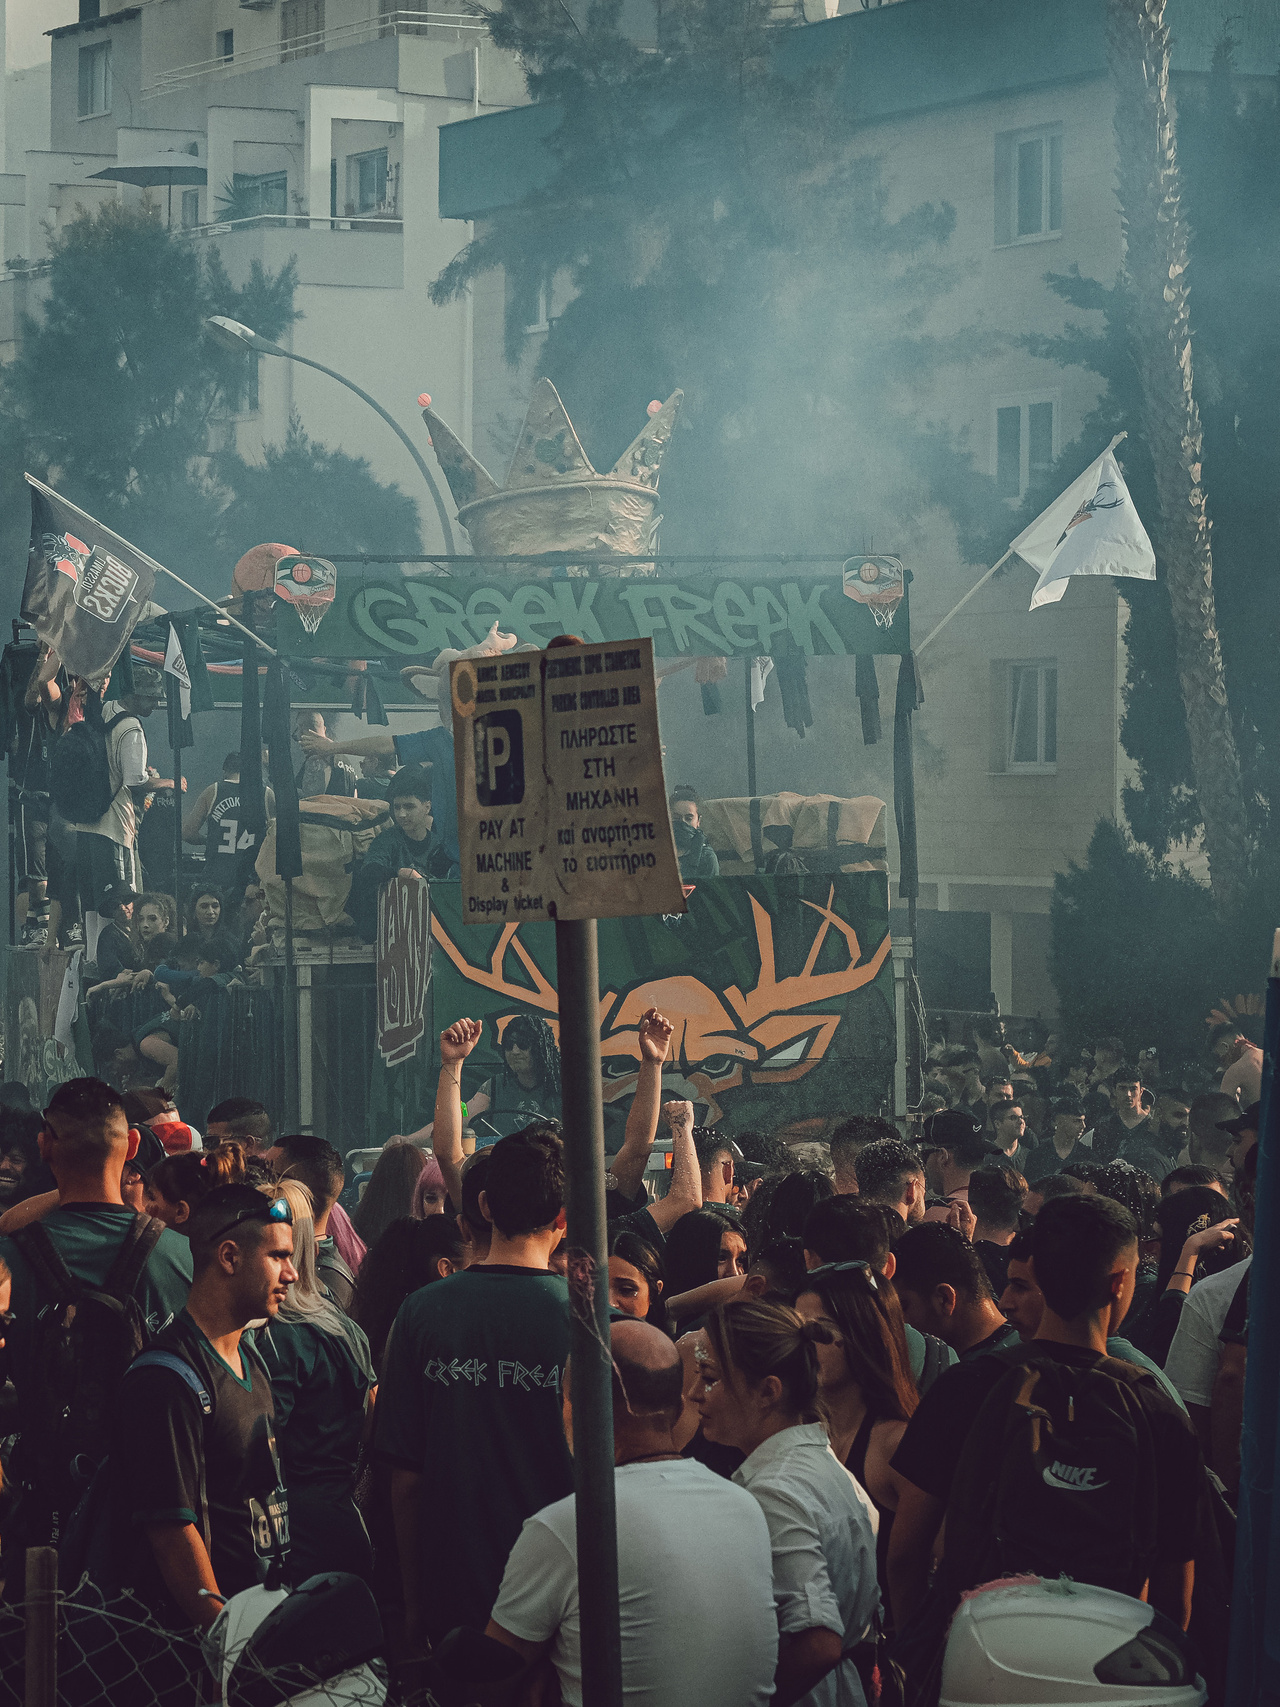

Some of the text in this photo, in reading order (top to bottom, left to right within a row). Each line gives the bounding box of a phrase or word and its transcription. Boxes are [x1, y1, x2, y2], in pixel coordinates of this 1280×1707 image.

[560, 723, 638, 750] ΠΛΗΡΩΣΤΕ
[487, 726, 511, 791] P
[583, 756, 616, 779] ΣΤΗ
[566, 787, 639, 811] ΜΗΧΑΝΗ
[479, 818, 525, 841] PAY AT
[476, 851, 533, 873] MACHINE
[501, 877, 510, 893] &
[468, 893, 544, 916] Display ticket
[494, 1360, 566, 1394] FREA
[1051, 1460, 1098, 1488] NIKE
